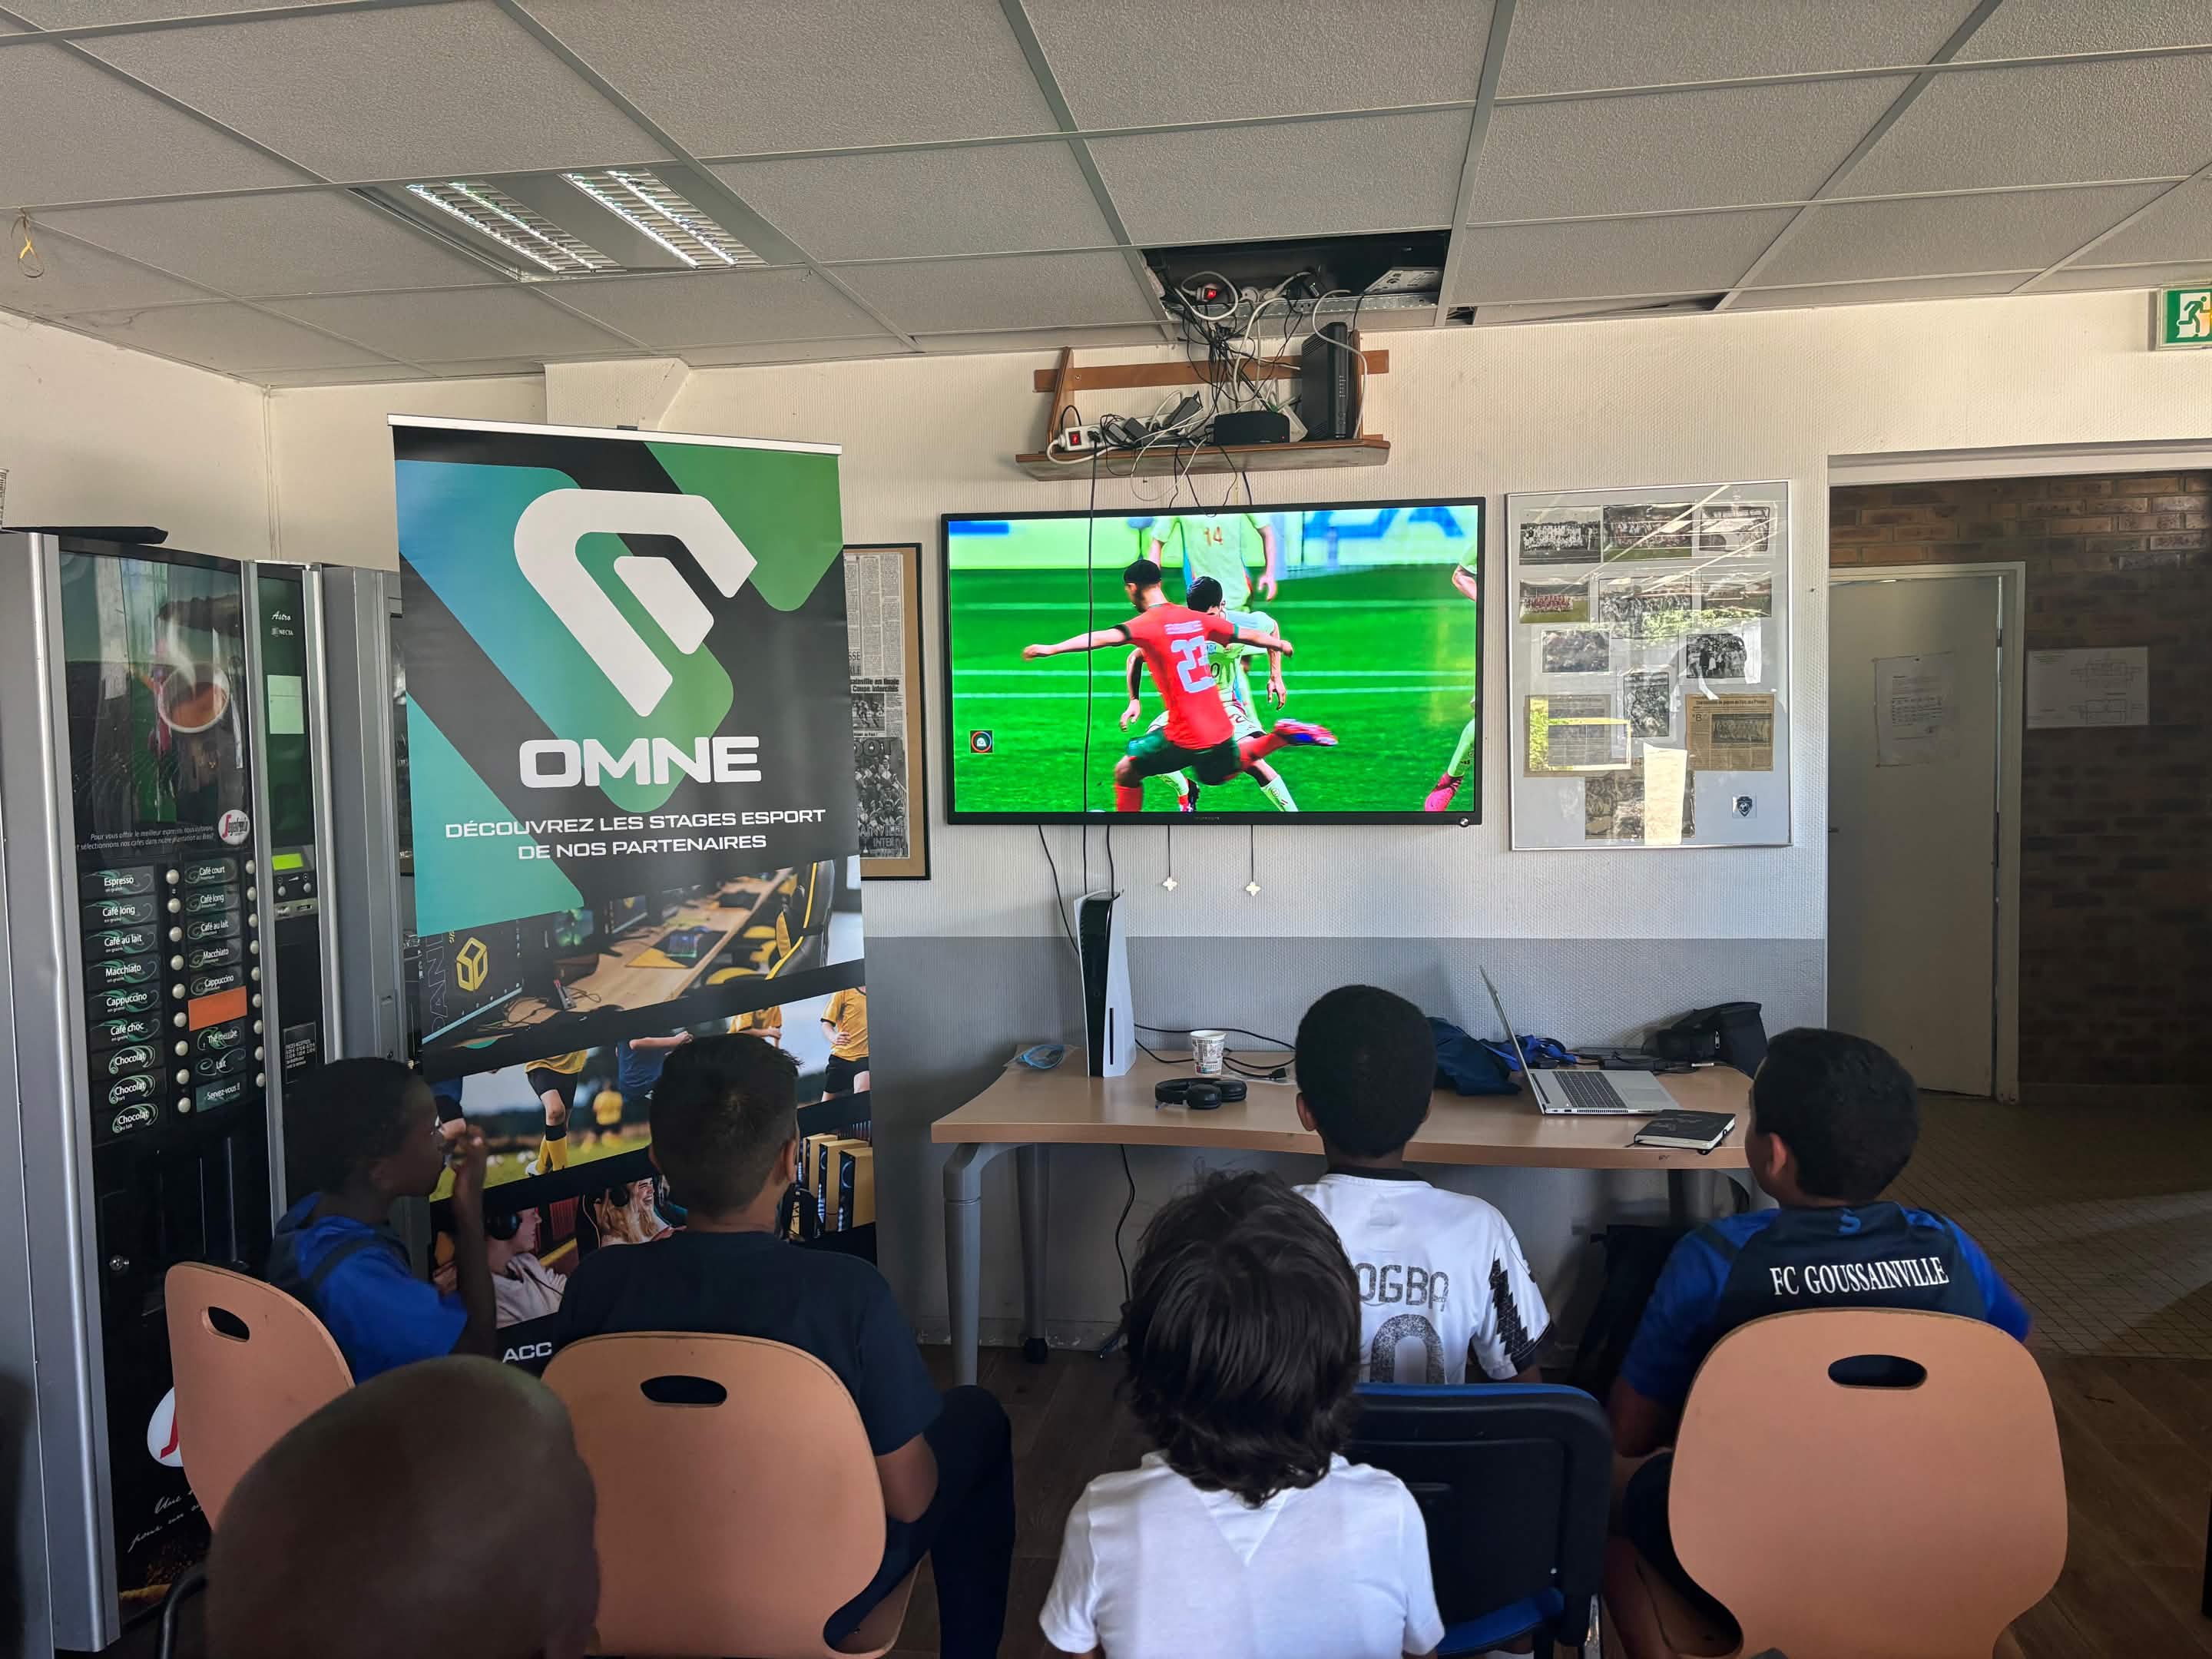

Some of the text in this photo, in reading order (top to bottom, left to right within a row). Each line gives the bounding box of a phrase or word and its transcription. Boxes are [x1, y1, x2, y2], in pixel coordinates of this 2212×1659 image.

[519, 736, 762, 788] OMNE
[445, 809, 826, 839] DÉCOUVREZ LES STAGES ESPORT
[518, 835, 767, 860] DE NOS PARTENAIRES
[200, 867, 211, 876] Café
[104, 877, 134, 887] Espresso
[200, 894, 224, 904] Café long
[102, 906, 135, 916] Café long
[200, 922, 213, 932] Café
[104, 937, 120, 946] Café
[131, 934, 142, 942] lait
[203, 948, 229, 959] Macchiato
[105, 965, 141, 977] Macchiato
[204, 975, 234, 988] Cappuccino
[106, 993, 147, 1008] Cappuccino
[110, 1022, 144, 1035] Café choc
[114, 1052, 147, 1066] Chocolat
[216, 1061, 227, 1069] Lait
[114, 1081, 147, 1096] Chocolat
[118, 1110, 150, 1125] Chocolat
[1770, 1257, 1949, 1296] FC GOUSSAINVILLE
